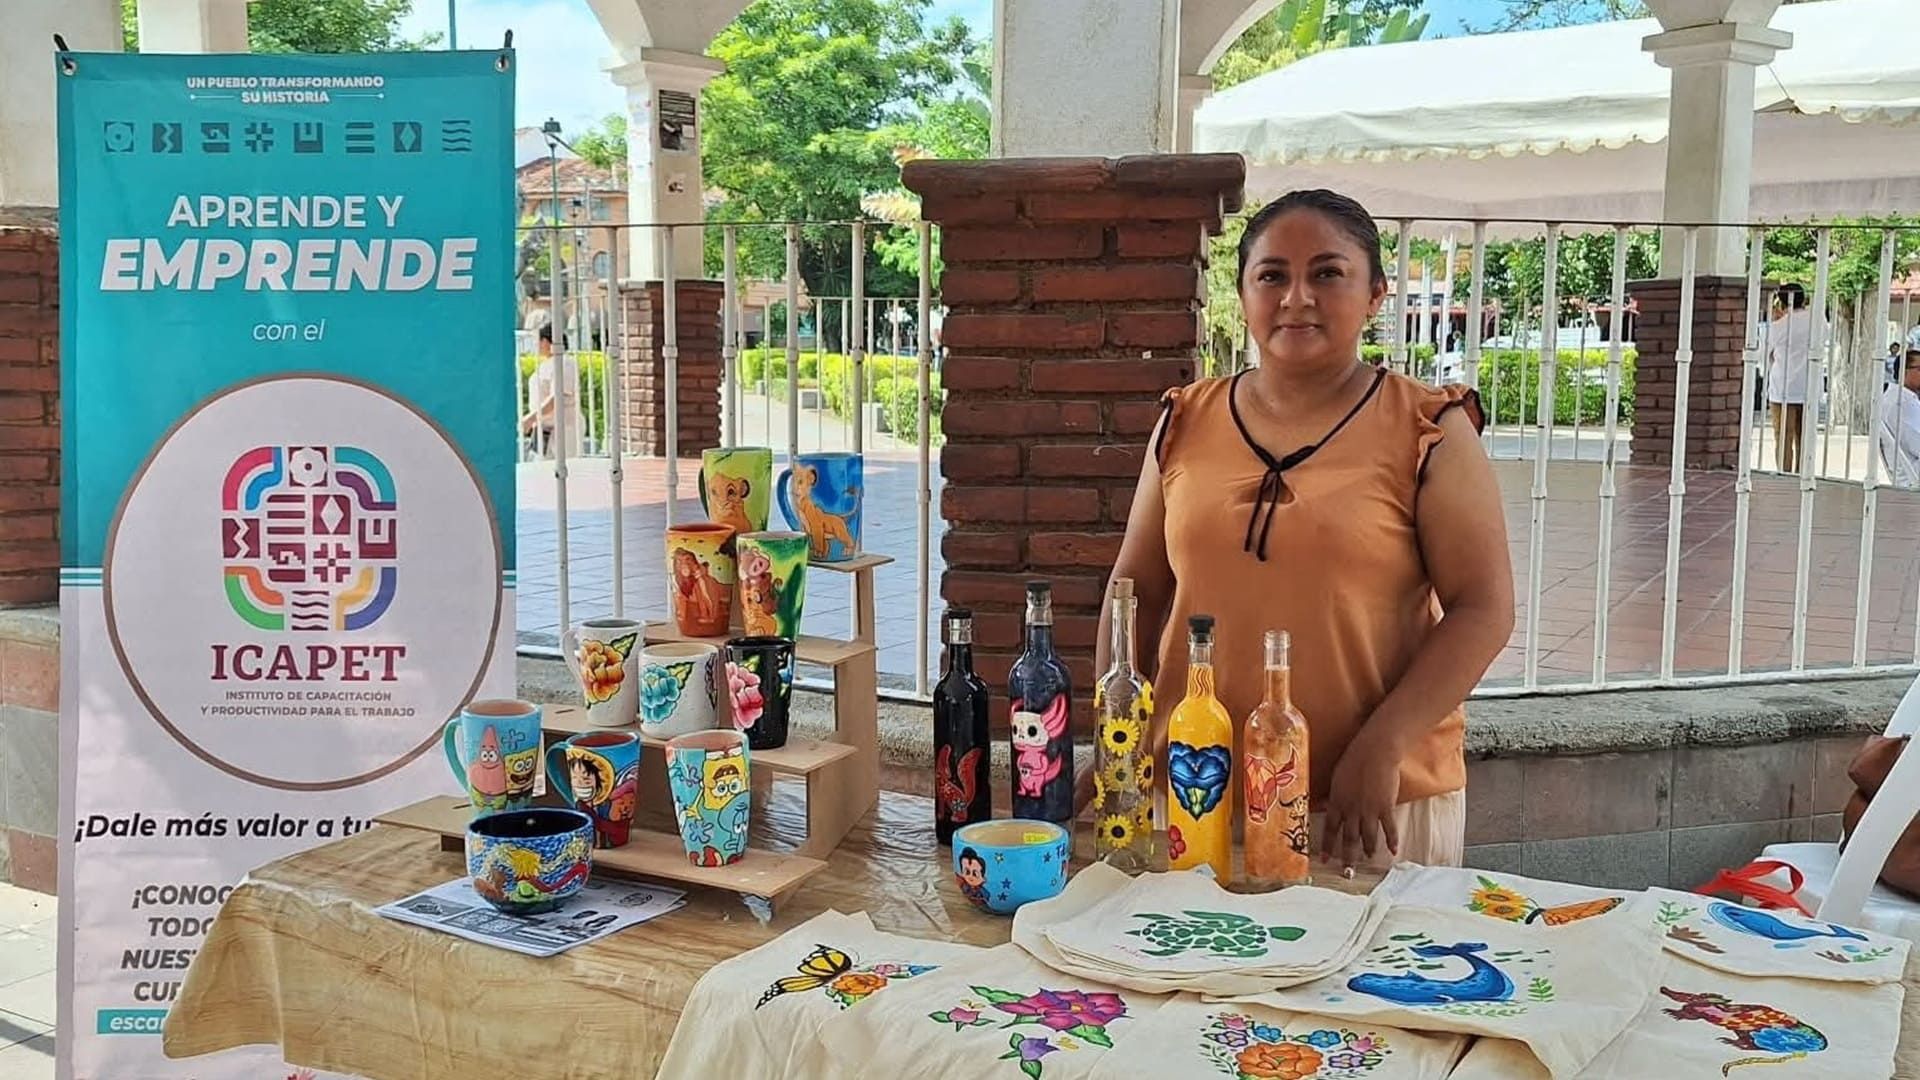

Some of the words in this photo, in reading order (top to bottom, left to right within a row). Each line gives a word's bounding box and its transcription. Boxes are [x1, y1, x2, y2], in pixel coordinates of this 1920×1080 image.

[187, 77, 206, 88] UN
[208, 77, 257, 88] PUEBLO
[259, 76, 384, 88] TRANSFORMANDO
[241, 92, 261, 103] SU
[263, 91, 330, 103] HISTORIA
[167, 195, 367, 228] APRENDE
[377, 195, 403, 228] Y
[100, 237, 478, 291] EMPRENDE
[253, 323, 296, 341] con
[303, 319, 325, 341] el
[211, 644, 406, 681] ICAPET
[226, 691, 284, 701] INSTITUTO
[287, 691, 303, 701] DE
[306, 689, 391, 702] CAPACITACIÓN
[201, 706, 209, 716] Y
[211, 706, 307, 716] PRODUCTIVIDAD
[310, 706, 341, 716] PARA
[345, 707, 358, 717] EL
[362, 707, 415, 717] TRABAJO
[75, 813, 157, 842] ¡Dale
[165, 812, 227, 837] más
[237, 813, 308, 837] valor
[317, 819, 333, 837] a
[121, 949, 197, 969] NUES
